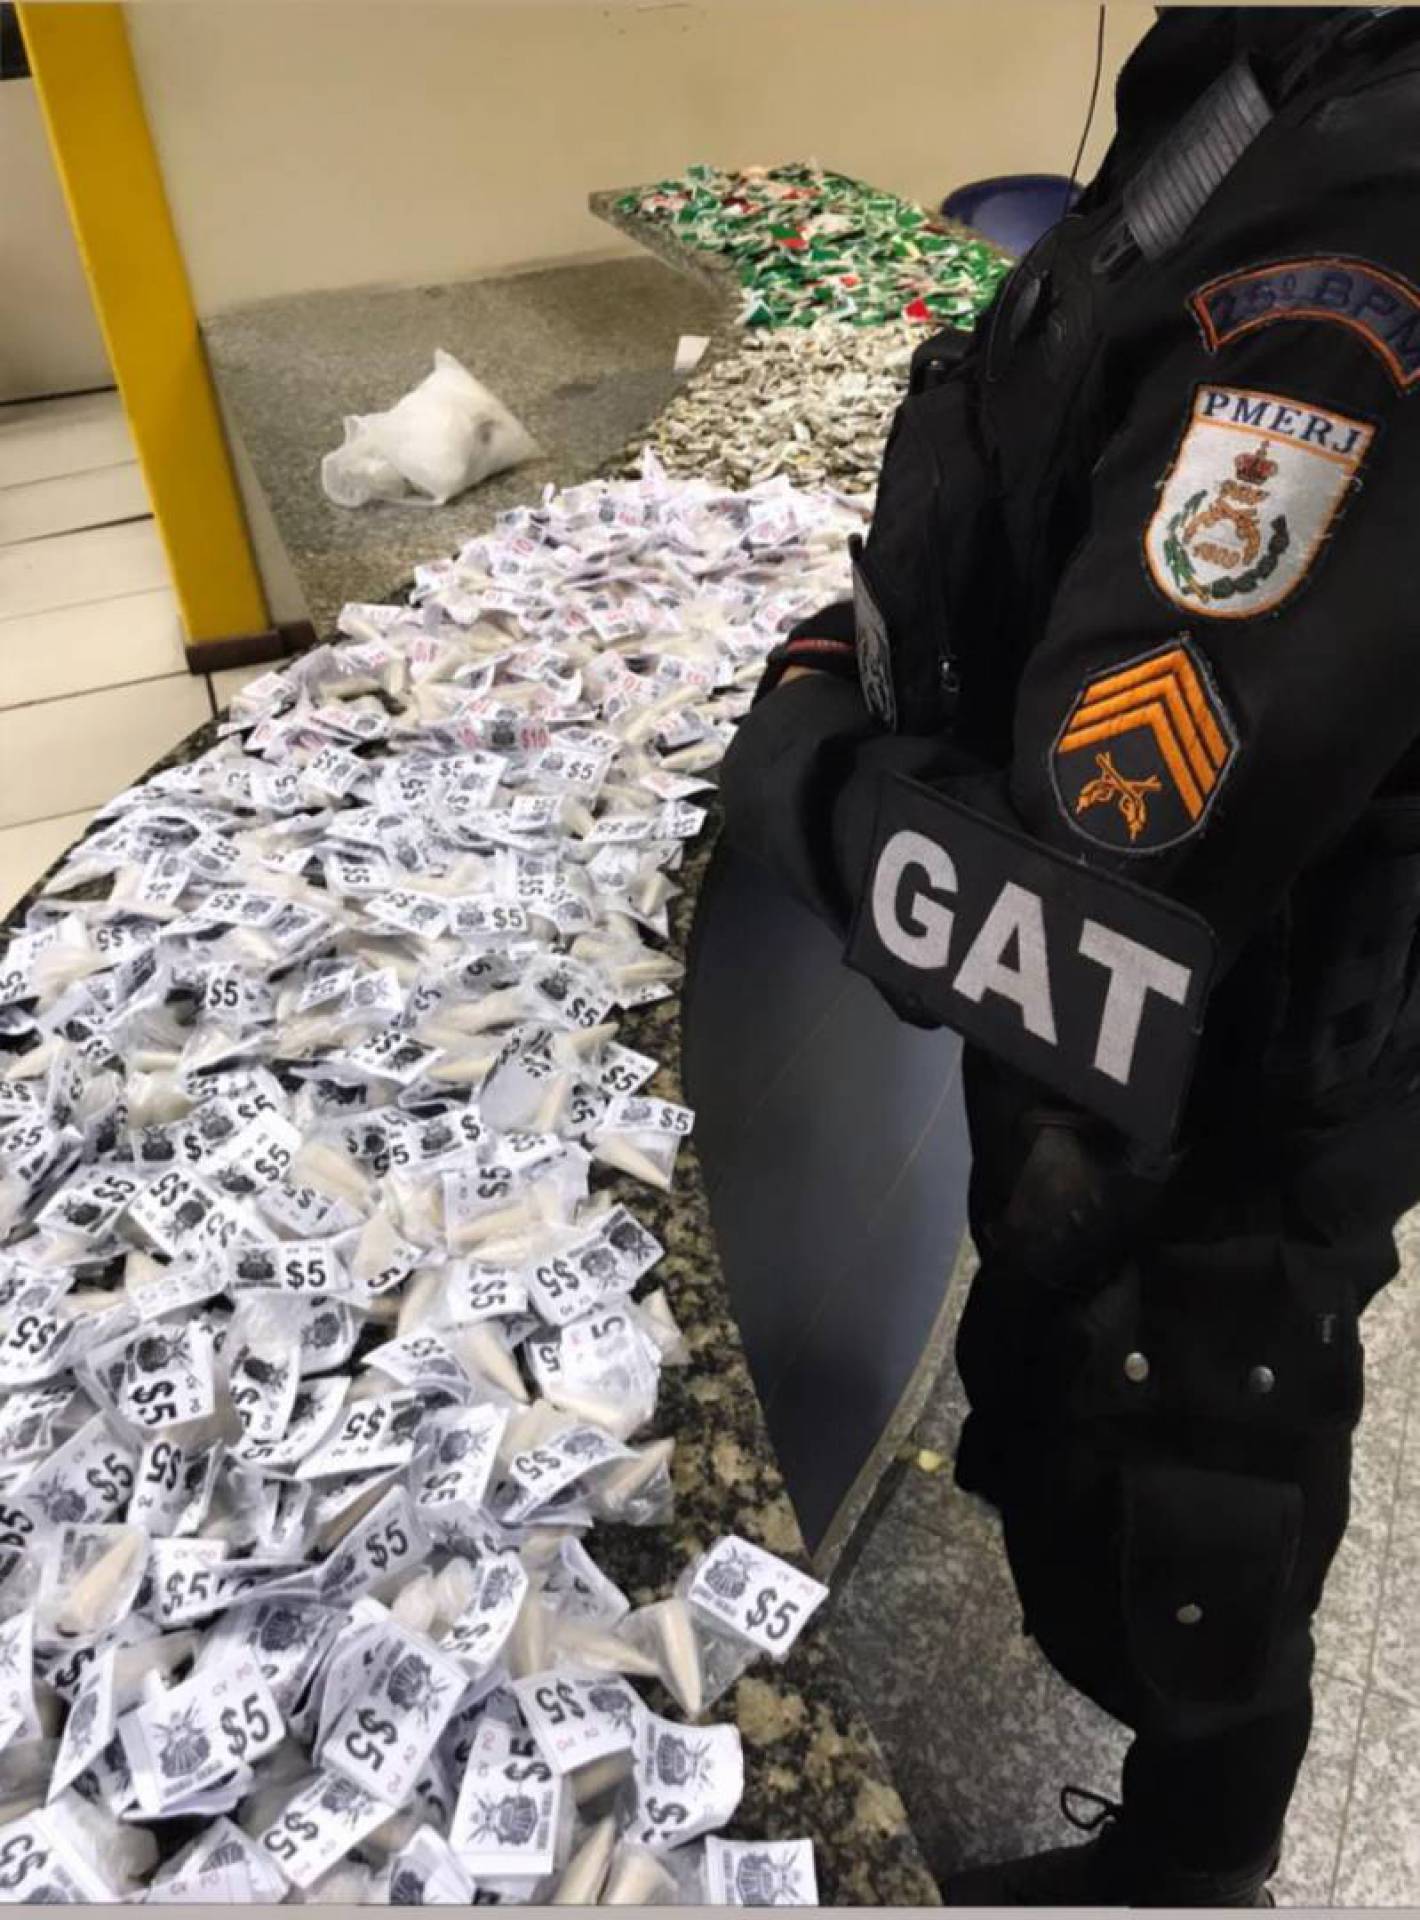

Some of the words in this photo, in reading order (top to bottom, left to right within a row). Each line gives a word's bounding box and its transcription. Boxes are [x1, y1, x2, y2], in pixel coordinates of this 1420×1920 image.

[1203, 390, 1361, 454] PMERJ
[567, 761, 595, 780] $5
[492, 906, 522, 928] $5
[97, 926, 124, 951] $5
[871, 829, 1194, 1087] GAT
[210, 978, 238, 1007] $5
[567, 997, 600, 1027] $5
[602, 1064, 639, 1092] $5
[659, 1106, 690, 1131] $5
[7, 1125, 44, 1151] $5
[255, 1142, 291, 1181] $5
[93, 1175, 136, 1203] $5
[150, 1172, 190, 1208] $5
[477, 1166, 512, 1198] $5
[285, 1260, 326, 1290] $5
[536, 1256, 580, 1298] $5
[470, 1280, 508, 1310] $5
[9, 1316, 57, 1354] $5
[130, 1381, 177, 1425] $5
[341, 1401, 386, 1441] $5
[86, 1453, 134, 1502] $5
[146, 1441, 182, 1491] $5
[515, 1450, 561, 1480] $5
[420, 1471, 463, 1505] $5
[365, 1519, 409, 1571] $5
[745, 1587, 800, 1640] $5
[534, 1678, 586, 1725] $5
[219, 1692, 270, 1758] $5
[345, 1707, 399, 1773] $5
[263, 1811, 319, 1861] $5
[0, 1834, 48, 1890] $5
